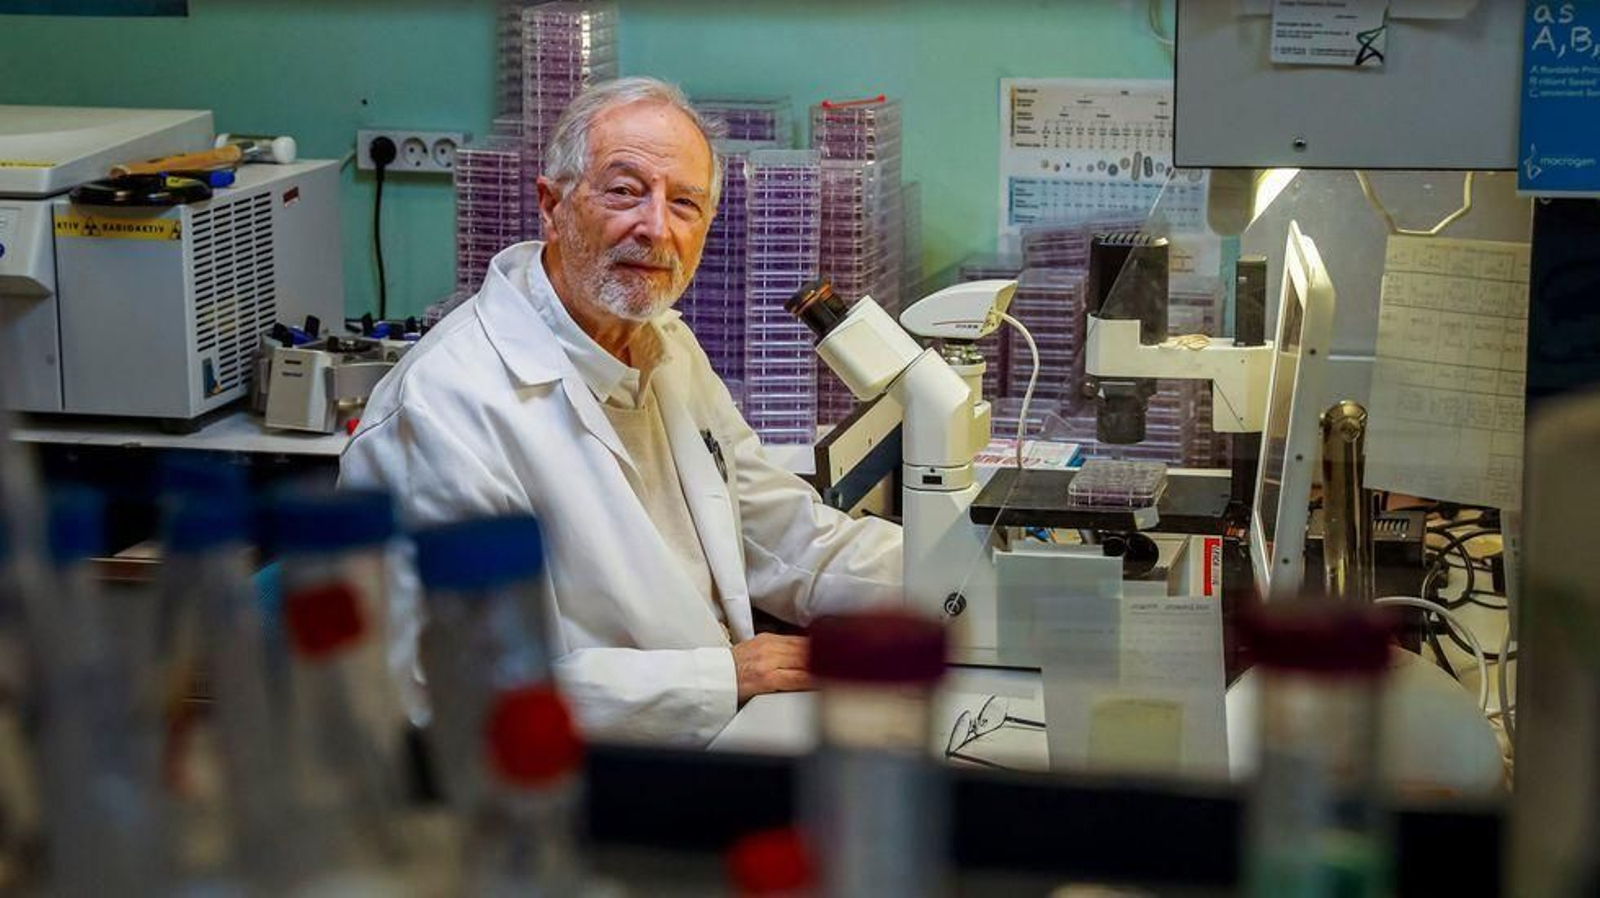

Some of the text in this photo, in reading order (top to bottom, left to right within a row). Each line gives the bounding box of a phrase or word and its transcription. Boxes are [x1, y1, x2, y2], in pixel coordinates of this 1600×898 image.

[1533, 4, 1576, 24] as
[1541, 157, 1596, 169] macrogen
[102, 222, 165, 233] RADIOAKTIV
